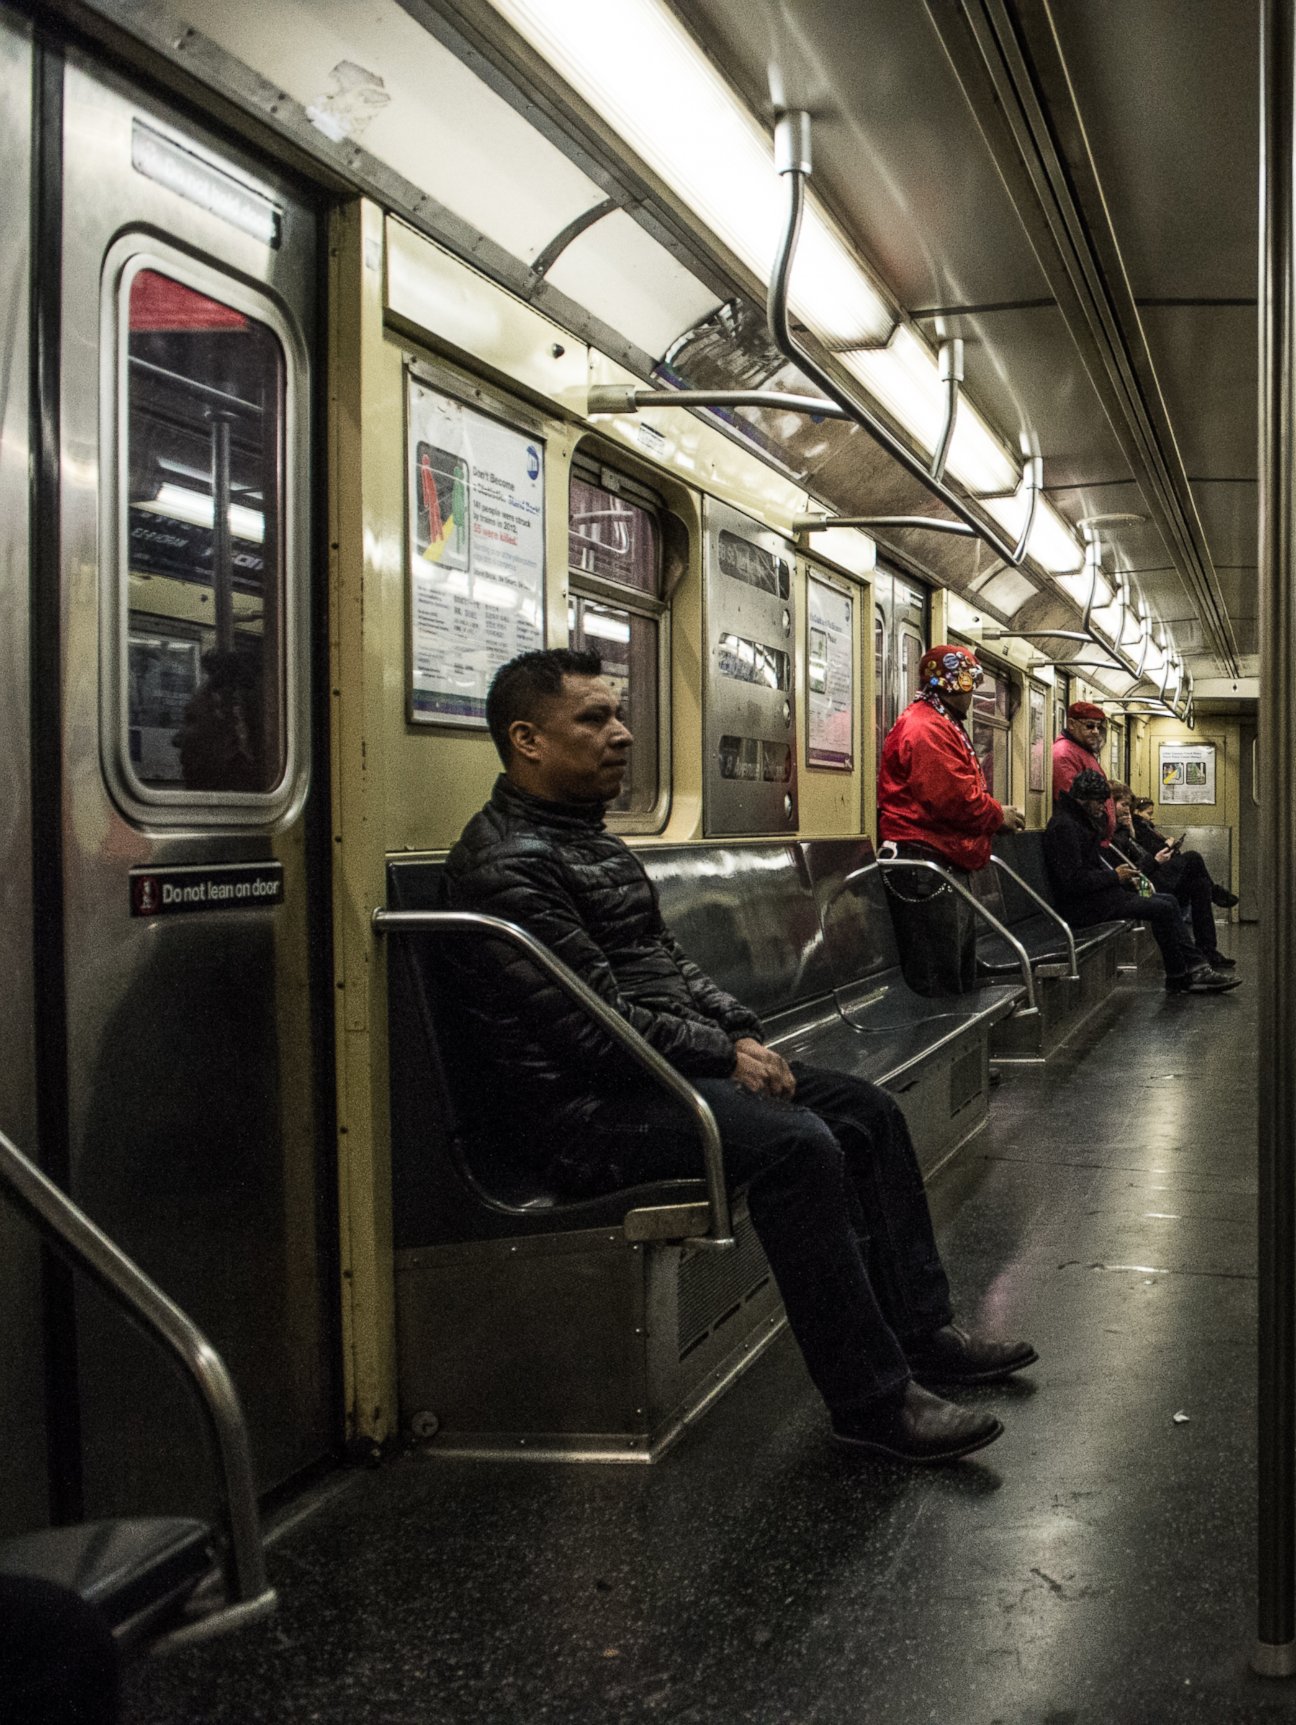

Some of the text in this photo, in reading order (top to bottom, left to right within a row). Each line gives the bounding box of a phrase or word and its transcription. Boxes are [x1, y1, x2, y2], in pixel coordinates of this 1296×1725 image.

[162, 877, 280, 904] Do not lean on door
